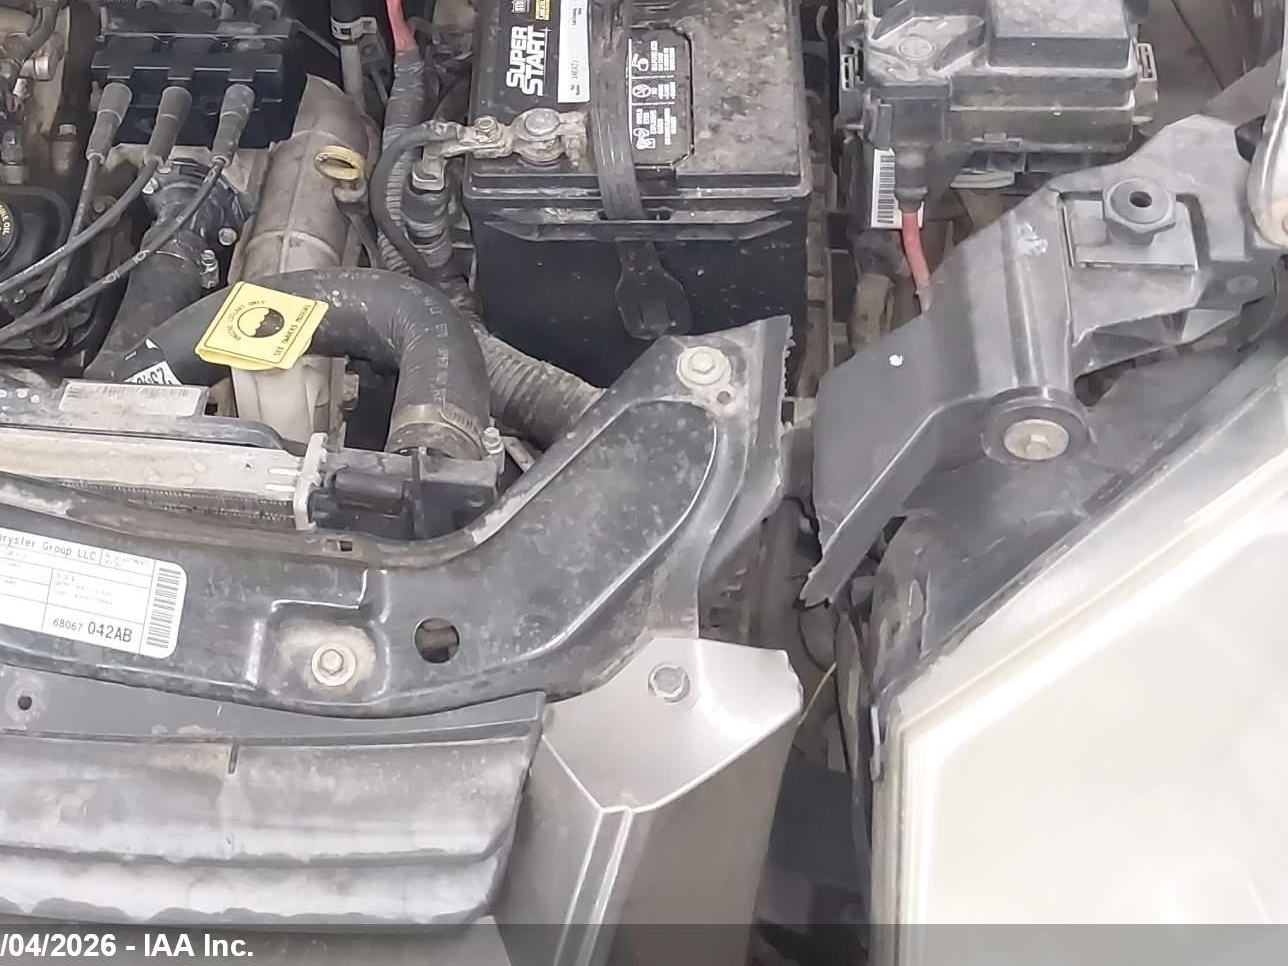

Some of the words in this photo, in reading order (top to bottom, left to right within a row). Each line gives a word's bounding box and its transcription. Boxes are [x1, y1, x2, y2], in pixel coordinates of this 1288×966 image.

[506, 25, 528, 88] SUPER
[522, 24, 546, 97] START
[2, 222, 11, 236] OIL
[42, 541, 73, 557] Group
[77, 548, 97, 561] LLC
[53, 618, 83, 633] 68067
[87, 621, 133, 644] 042AB
